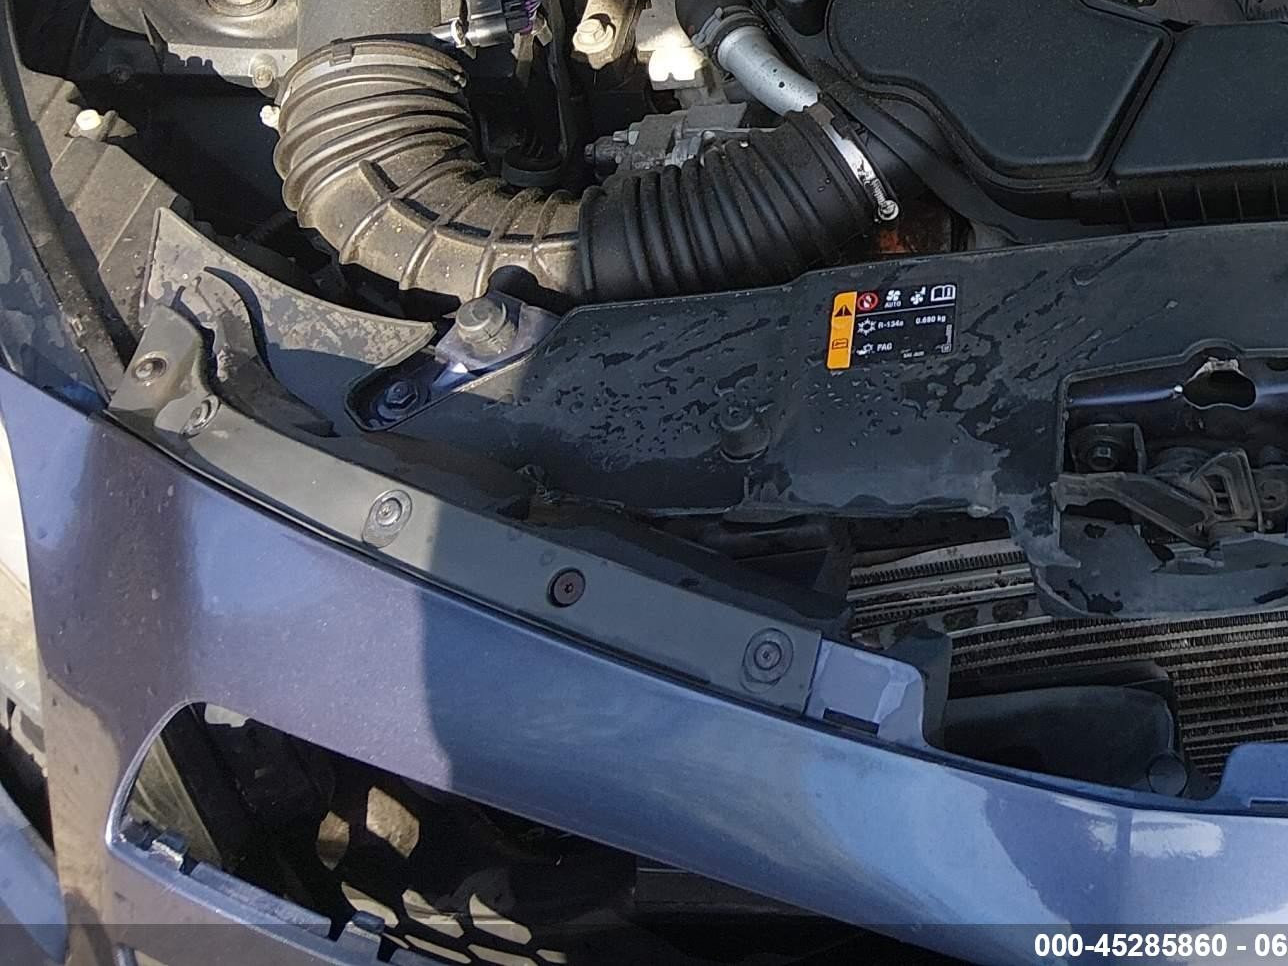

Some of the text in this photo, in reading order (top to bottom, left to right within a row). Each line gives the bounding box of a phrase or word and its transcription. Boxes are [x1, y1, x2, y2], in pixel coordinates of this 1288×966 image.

[884, 301, 902, 309] AUTO
[878, 320, 904, 329] R-134a
[876, 342, 893, 352] PAG
